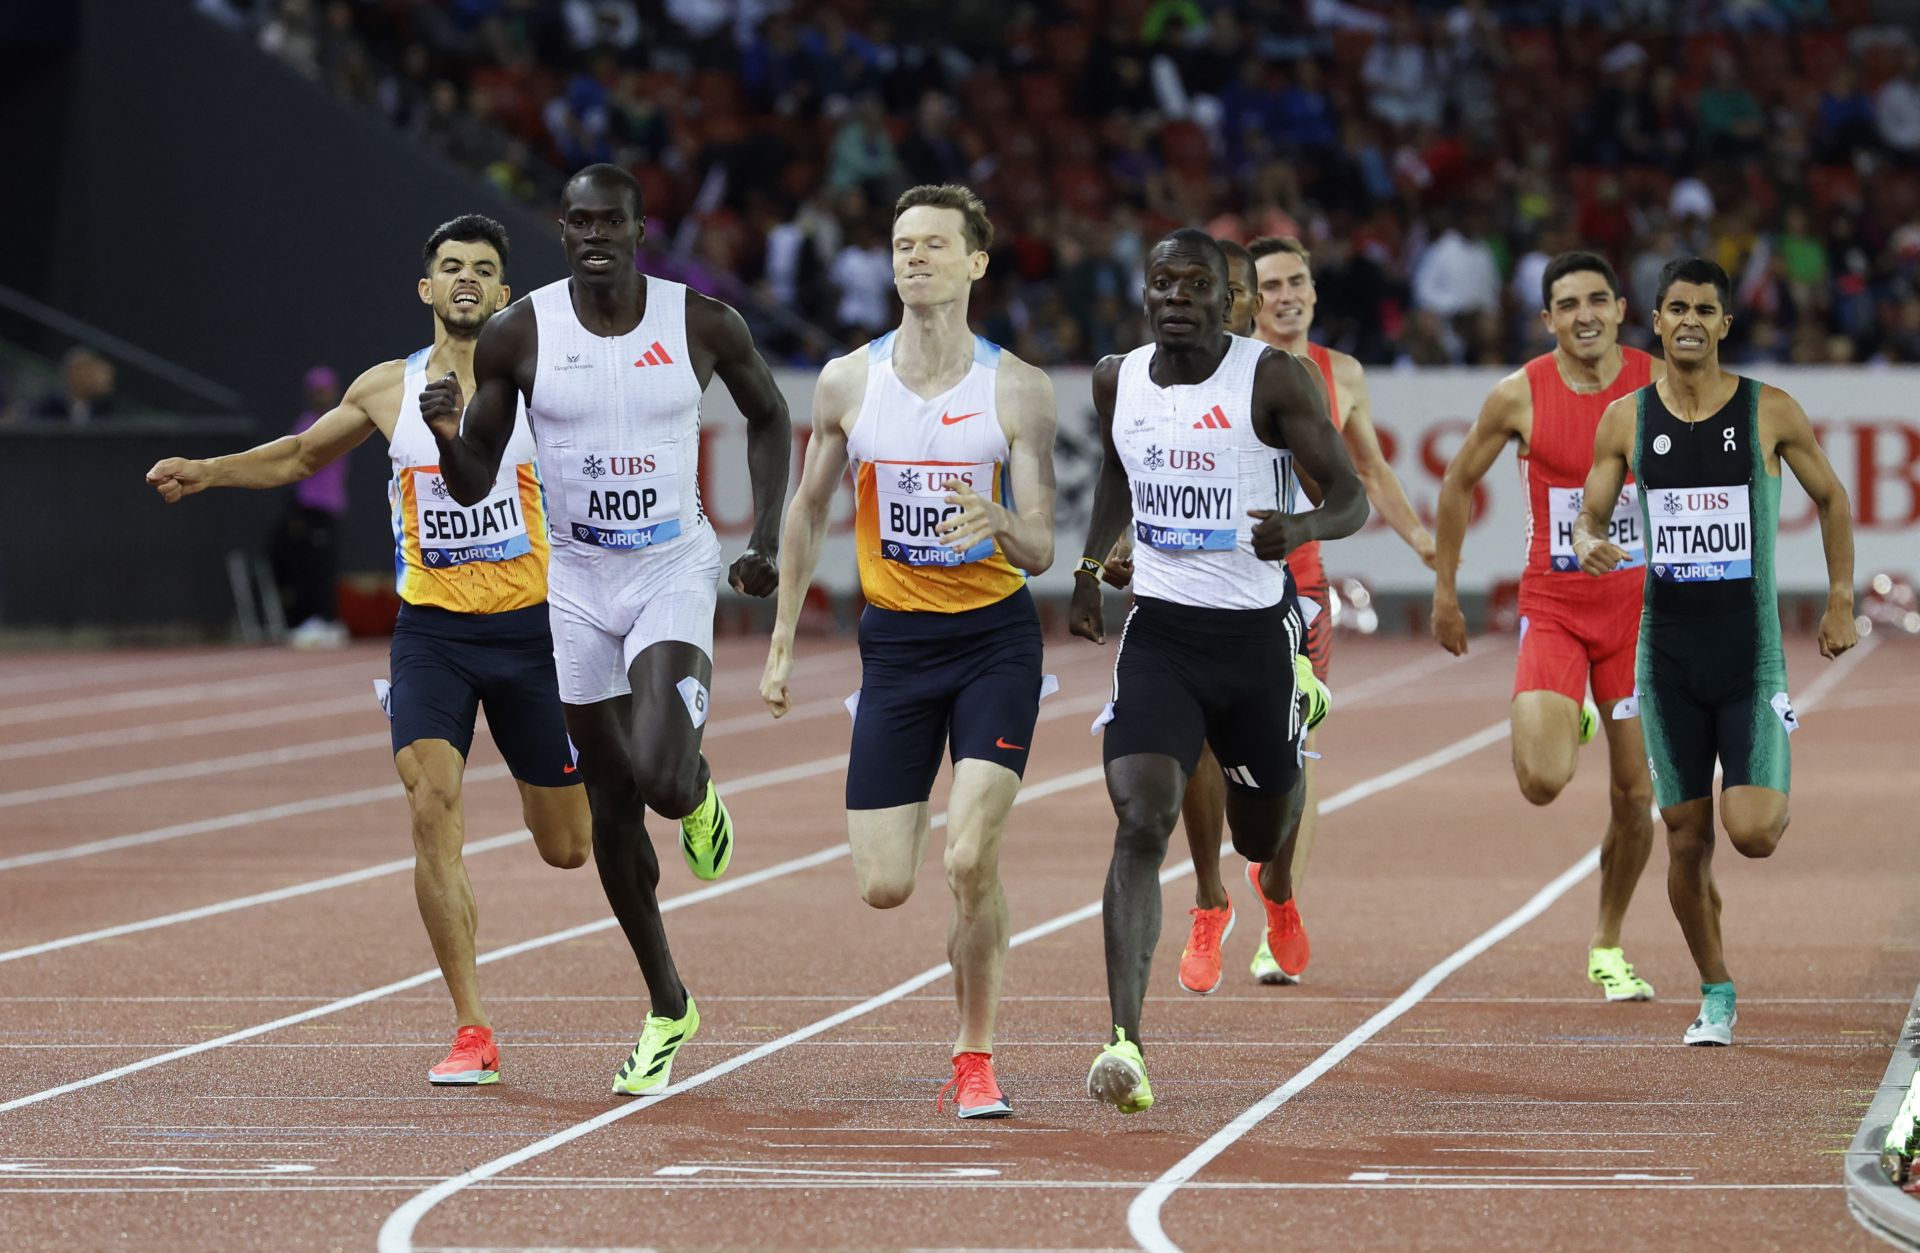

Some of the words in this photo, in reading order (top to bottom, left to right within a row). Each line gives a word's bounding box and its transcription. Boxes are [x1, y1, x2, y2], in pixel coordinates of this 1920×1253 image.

[609, 454, 656, 476] UBS
[1169, 449, 1216, 471] UBS
[588, 488, 657, 521] AROP
[1134, 479, 1232, 520] WANYONYI
[1687, 493, 1729, 511] UBS
[424, 497, 518, 539] SEDJATI
[597, 530, 652, 545] ZURICH
[1151, 530, 1204, 546] ZURICH
[1558, 518, 1639, 546] HPEL
[1656, 522, 1746, 554] ATTAOUI
[449, 545, 504, 563] ZURICH
[908, 548, 965, 563] ZURICH
[1673, 564, 1725, 579] ZURICH
[695, 689, 704, 712] 6
